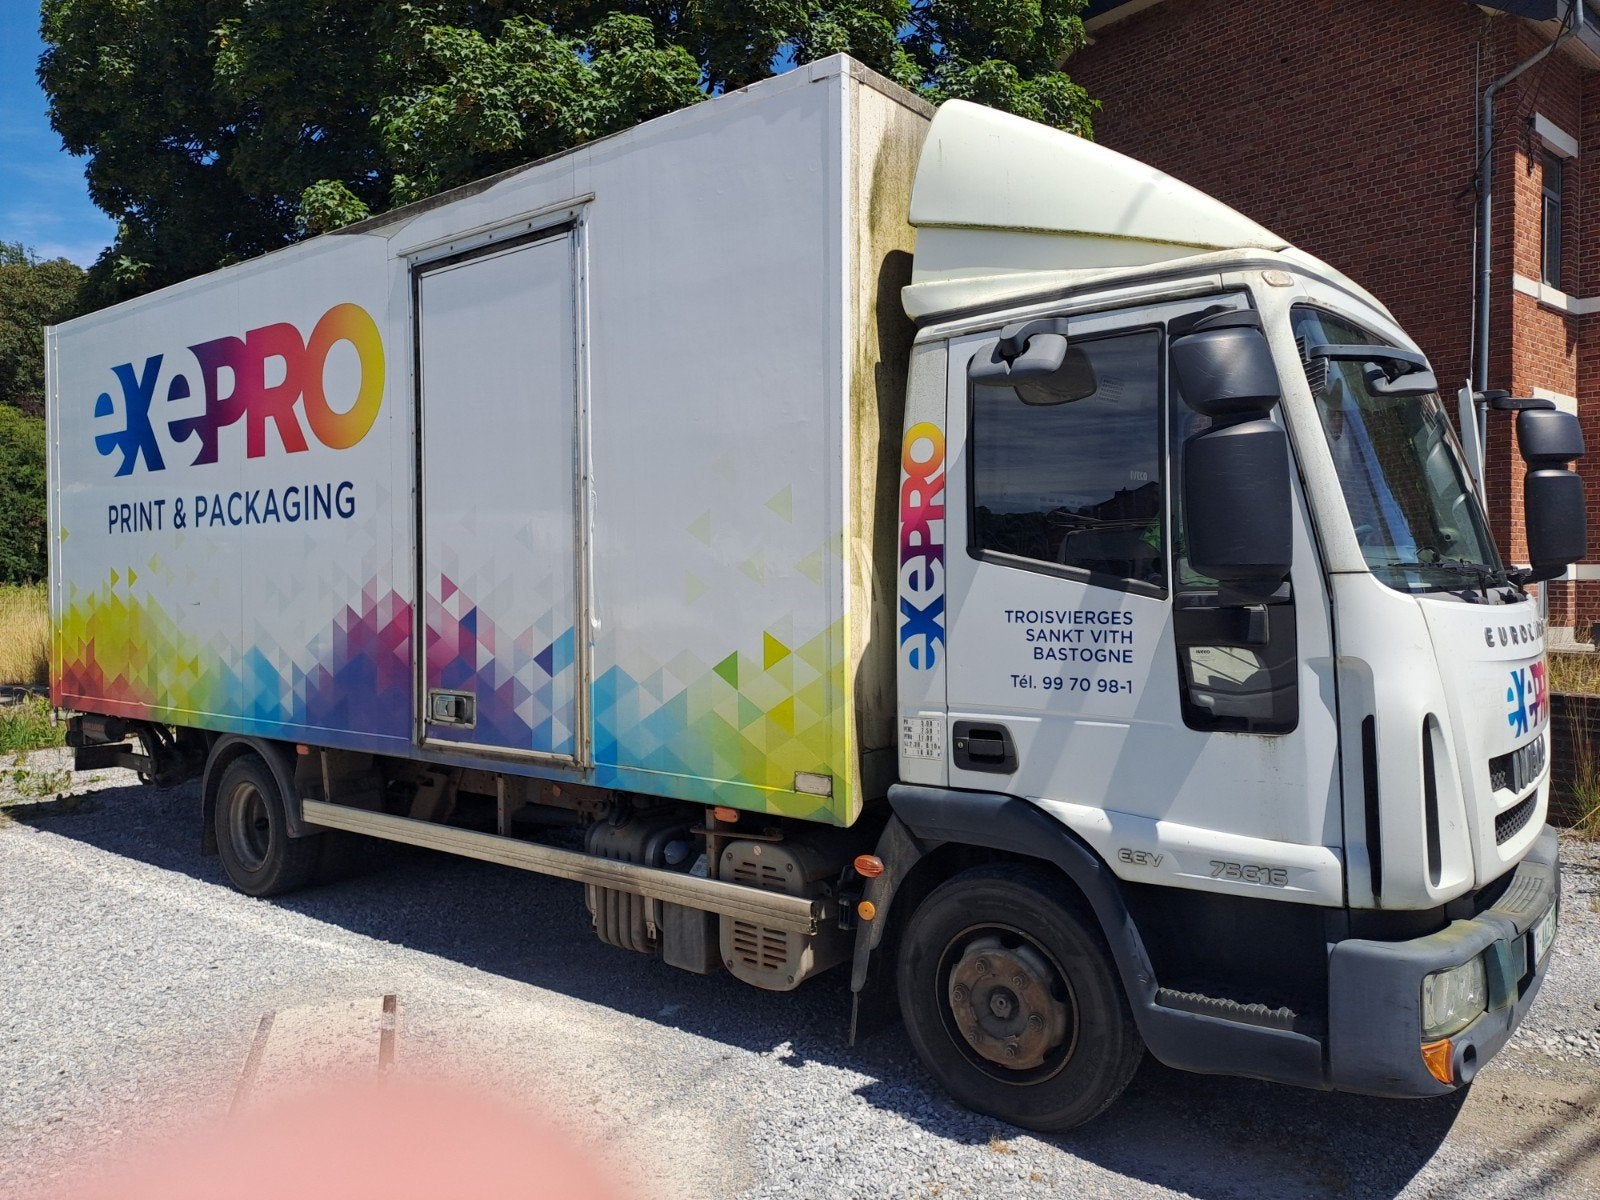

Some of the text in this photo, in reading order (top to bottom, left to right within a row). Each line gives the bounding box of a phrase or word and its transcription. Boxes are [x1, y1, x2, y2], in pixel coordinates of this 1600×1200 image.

[108, 481, 355, 534] PRINT & PACKAGING
[1005, 610, 1133, 625] TROISVIERGES
[1026, 629, 1133, 644] SANKT VITH
[1034, 647, 1133, 664] BASTOGNE
[1010, 675, 1132, 694] Tél. 99 70 98-1
[1117, 848, 1163, 867] EEV
[1209, 860, 1289, 887] 75E16
